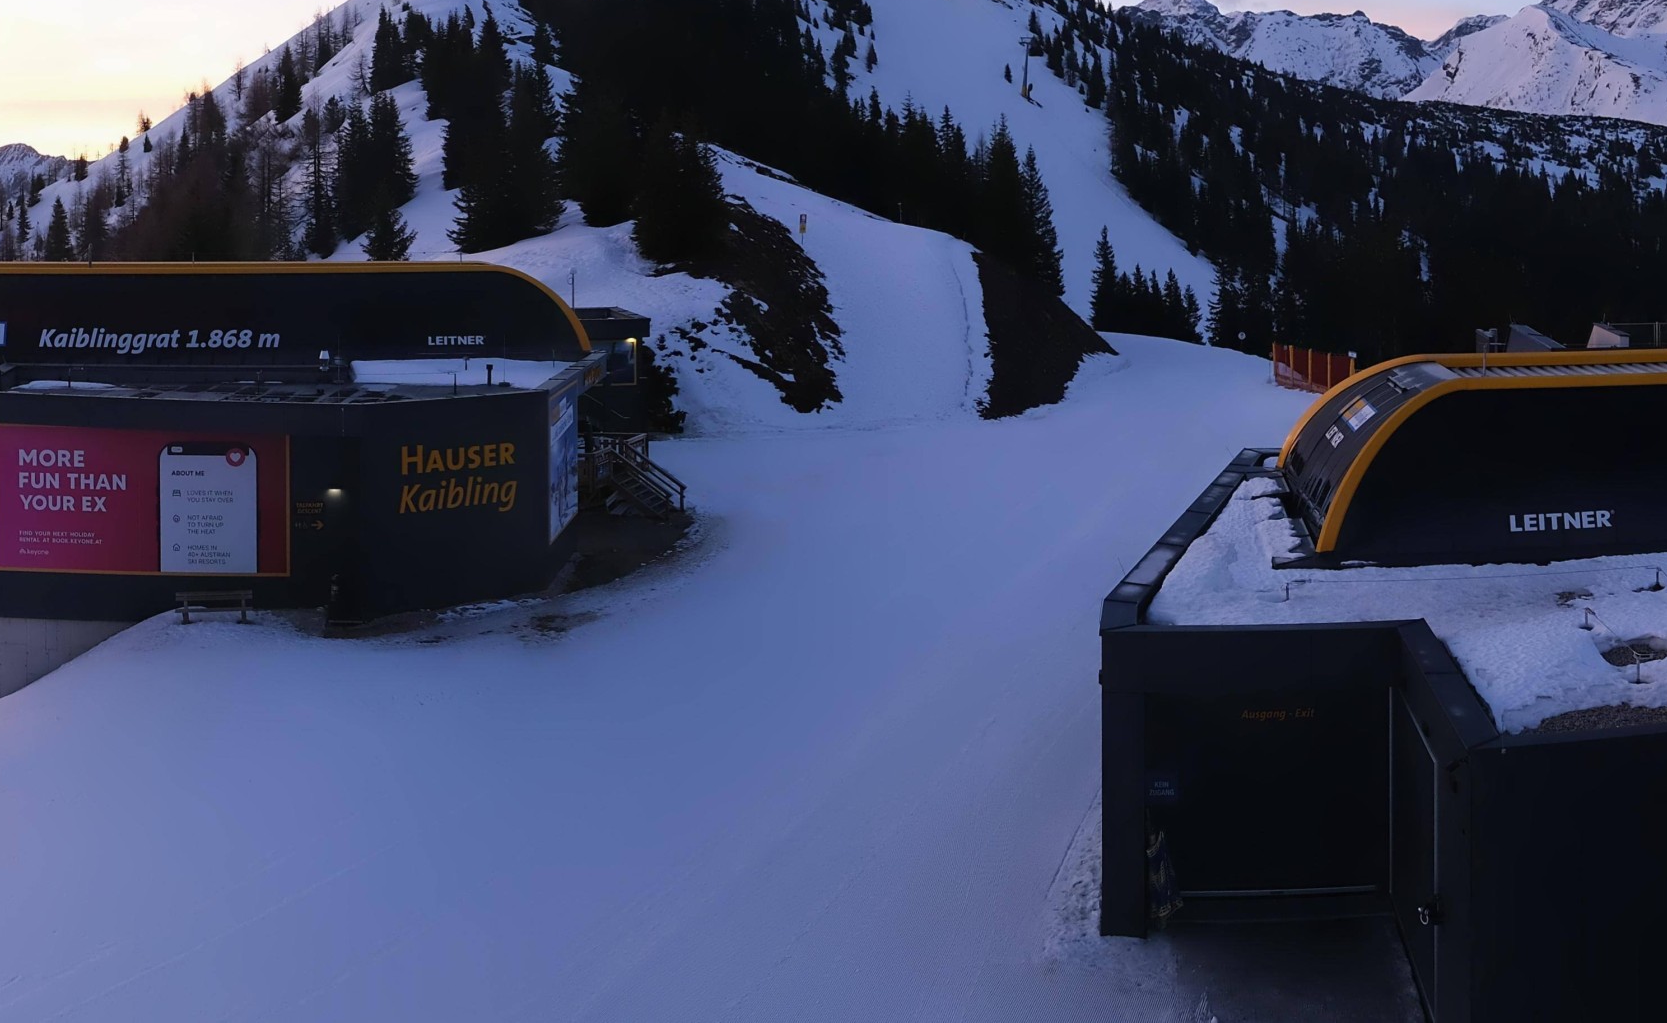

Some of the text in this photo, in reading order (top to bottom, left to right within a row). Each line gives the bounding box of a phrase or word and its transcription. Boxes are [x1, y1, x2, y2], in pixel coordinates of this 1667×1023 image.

[38, 327, 281, 354] Kaiblinggrat 1.868 m
[427, 335, 485, 346] LEITNER
[18, 448, 85, 468] MORE
[401, 442, 515, 476] HAUSER
[18, 472, 127, 491] FUN THAN
[19, 494, 107, 512] YOUR EX
[399, 476, 518, 514] Kaibling
[1509, 510, 1612, 533] LEITNER
[1240, 709, 1287, 722] Ausgang
[1295, 707, 1315, 718] Exit
